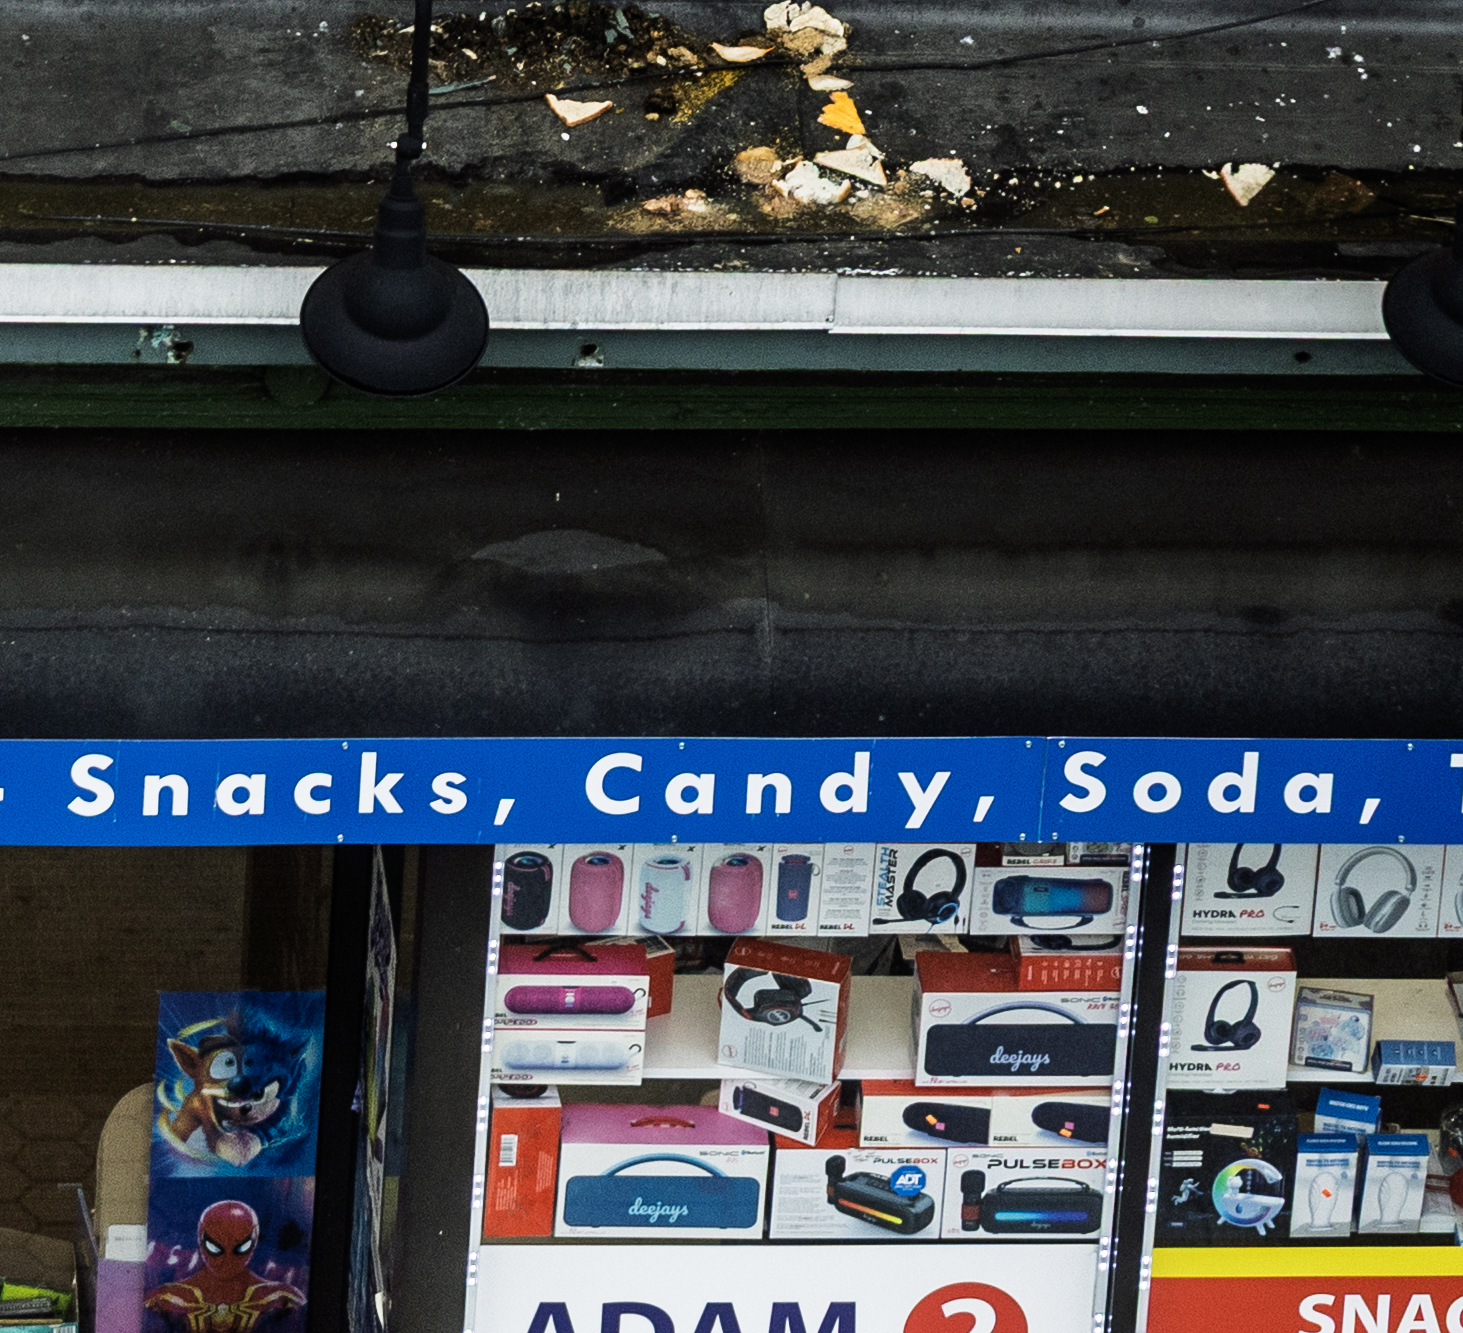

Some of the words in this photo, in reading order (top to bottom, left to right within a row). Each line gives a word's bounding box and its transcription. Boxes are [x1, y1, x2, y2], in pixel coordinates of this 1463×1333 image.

[68, 752, 515, 826] Snacks,
[586, 752, 995, 830] Candy,
[1060, 752, 1381, 826] Soda,
[877, 847, 889, 907] STEALTH
[886, 849, 898, 907] MASTER
[1192, 909, 1237, 919] HYDRA
[1239, 908, 1266, 919] PRO
[989, 1046, 1051, 1072] deejays
[1169, 1062, 1212, 1071] HYDRA
[1215, 1061, 1241, 1071] PRO
[987, 1158, 1107, 1169] PULSEBOX
[895, 1173, 923, 1186] ADT
[628, 1197, 689, 1223] deejays
